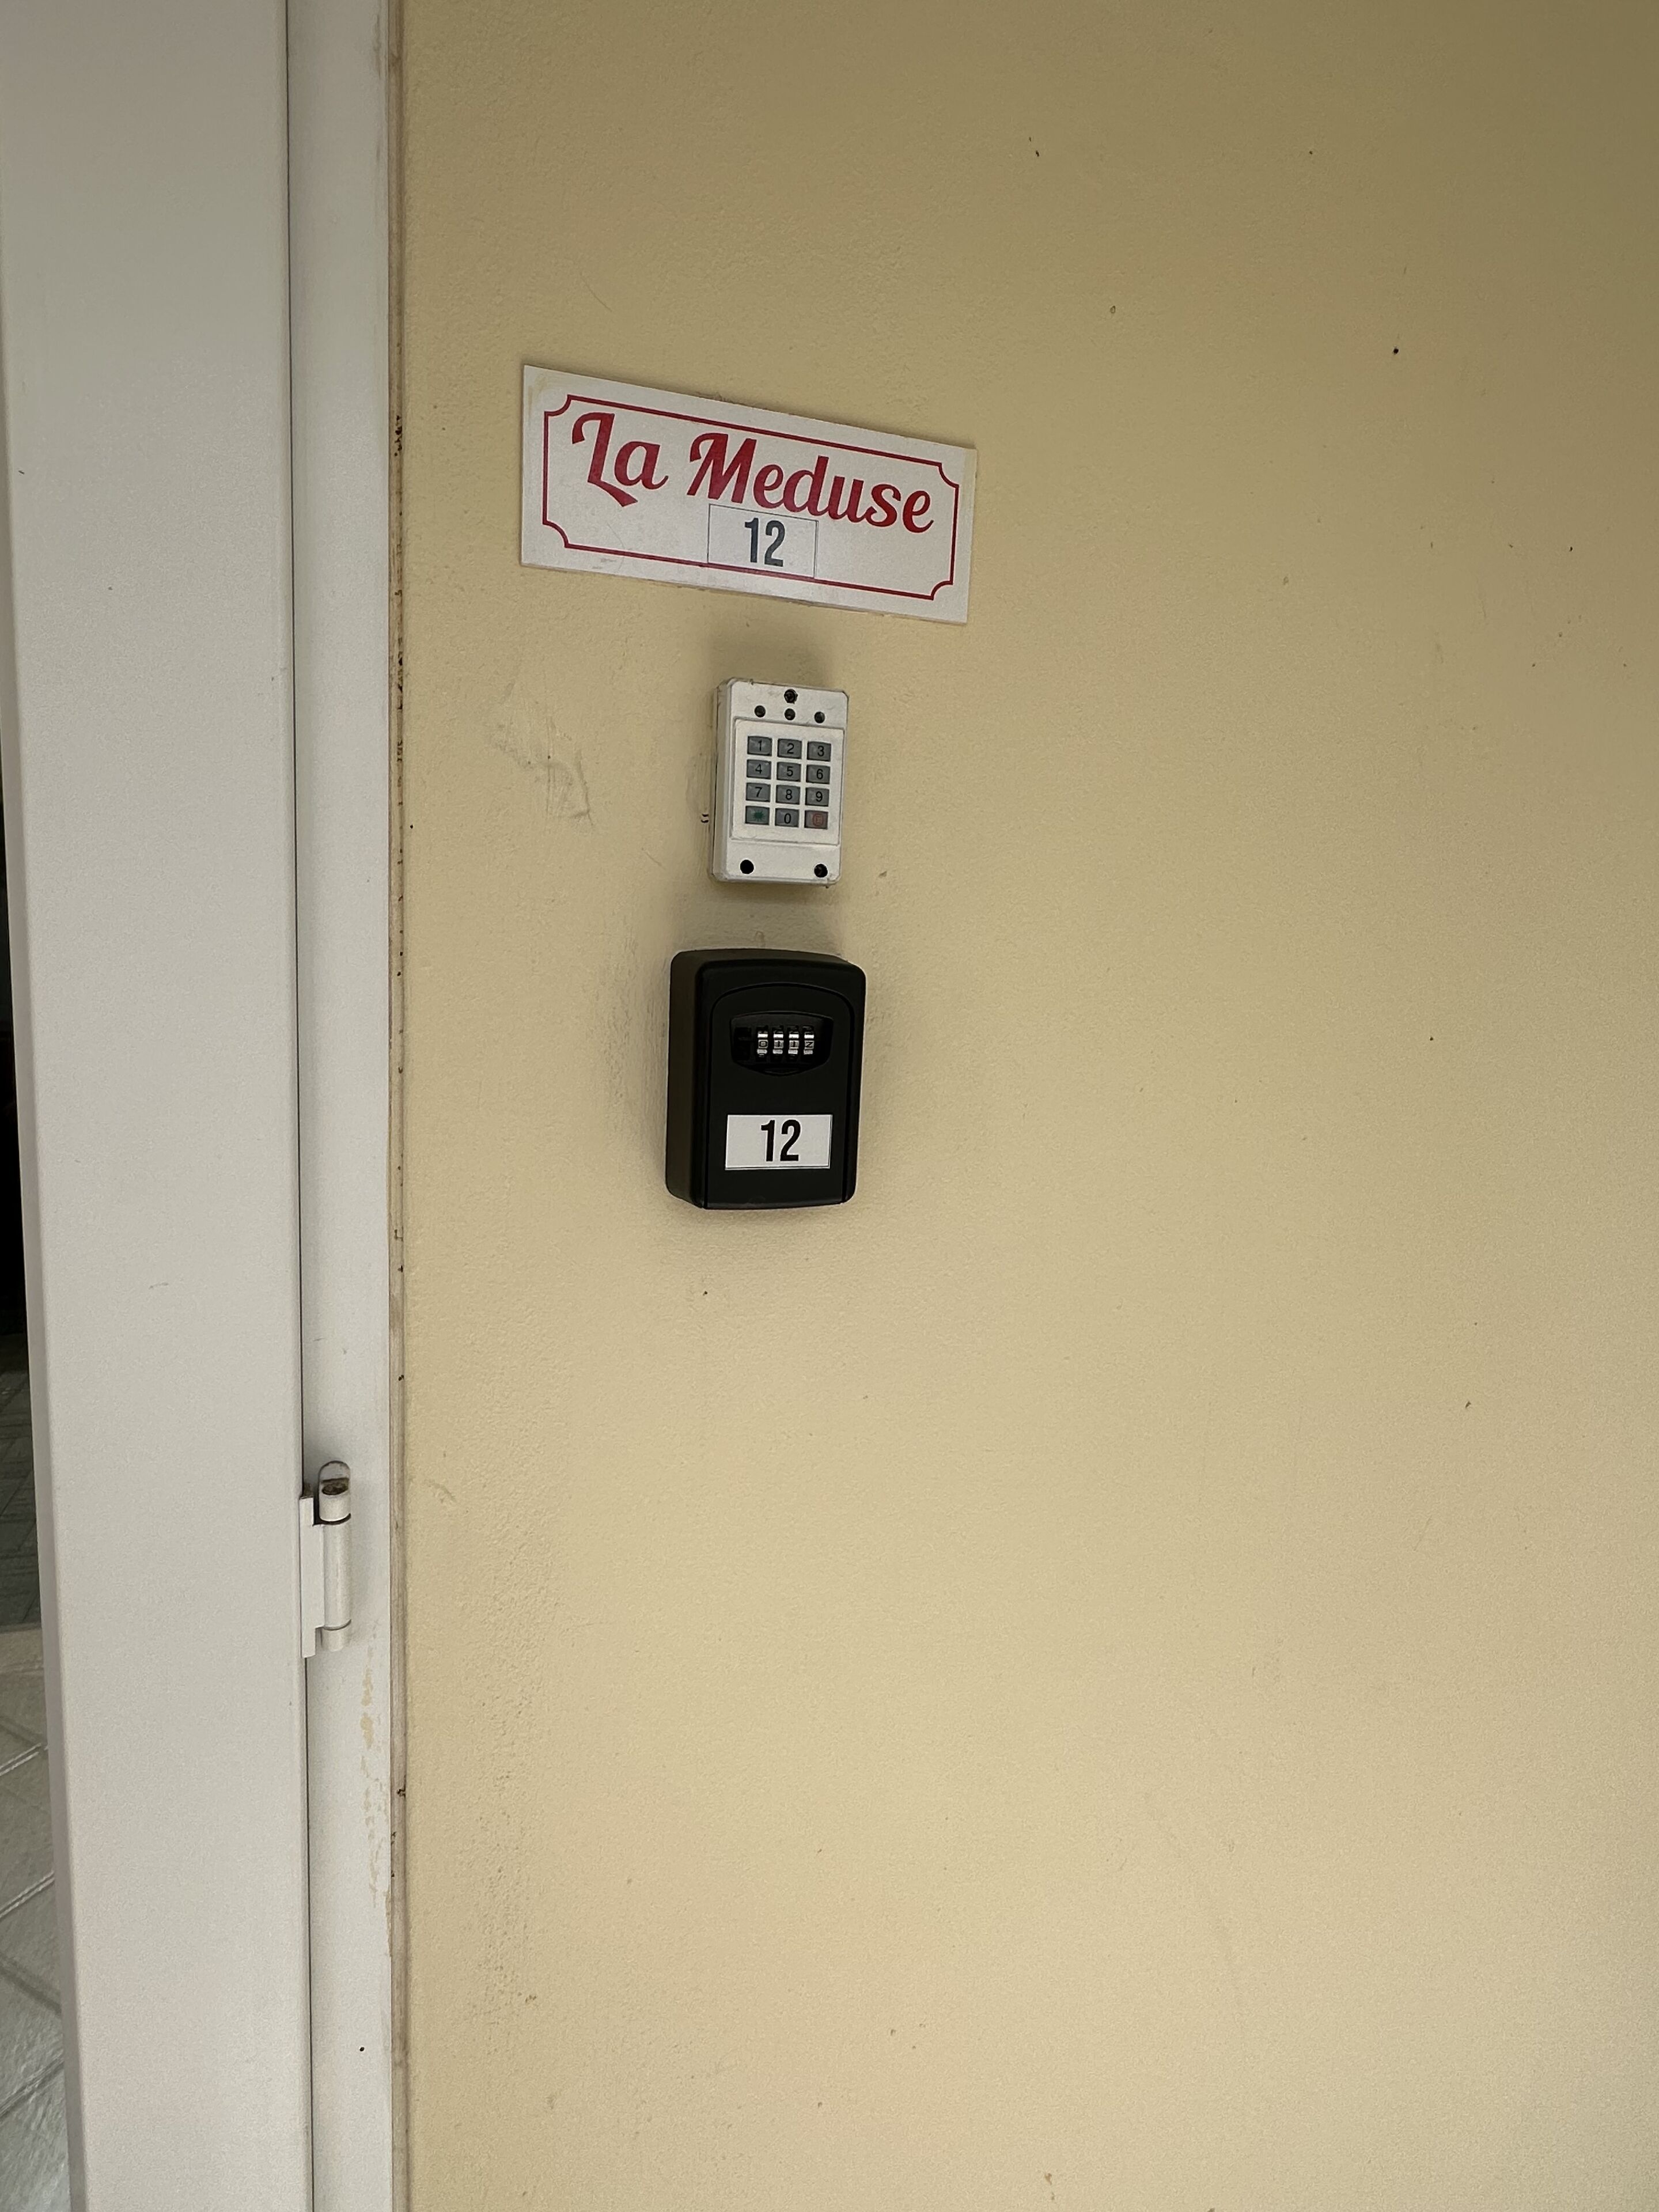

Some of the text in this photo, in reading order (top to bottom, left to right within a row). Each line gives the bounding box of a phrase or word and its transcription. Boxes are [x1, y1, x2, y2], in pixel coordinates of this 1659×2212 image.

[572, 412, 934, 533] La Meduse
[744, 517, 786, 567] 12
[787, 743, 794, 755] 2
[817, 745, 825, 757] 3
[755, 764, 824, 780] 4 5 6
[755, 787, 823, 802] 7 8 9
[784, 813, 791, 824] 0
[760, 1119, 801, 1162] 12
